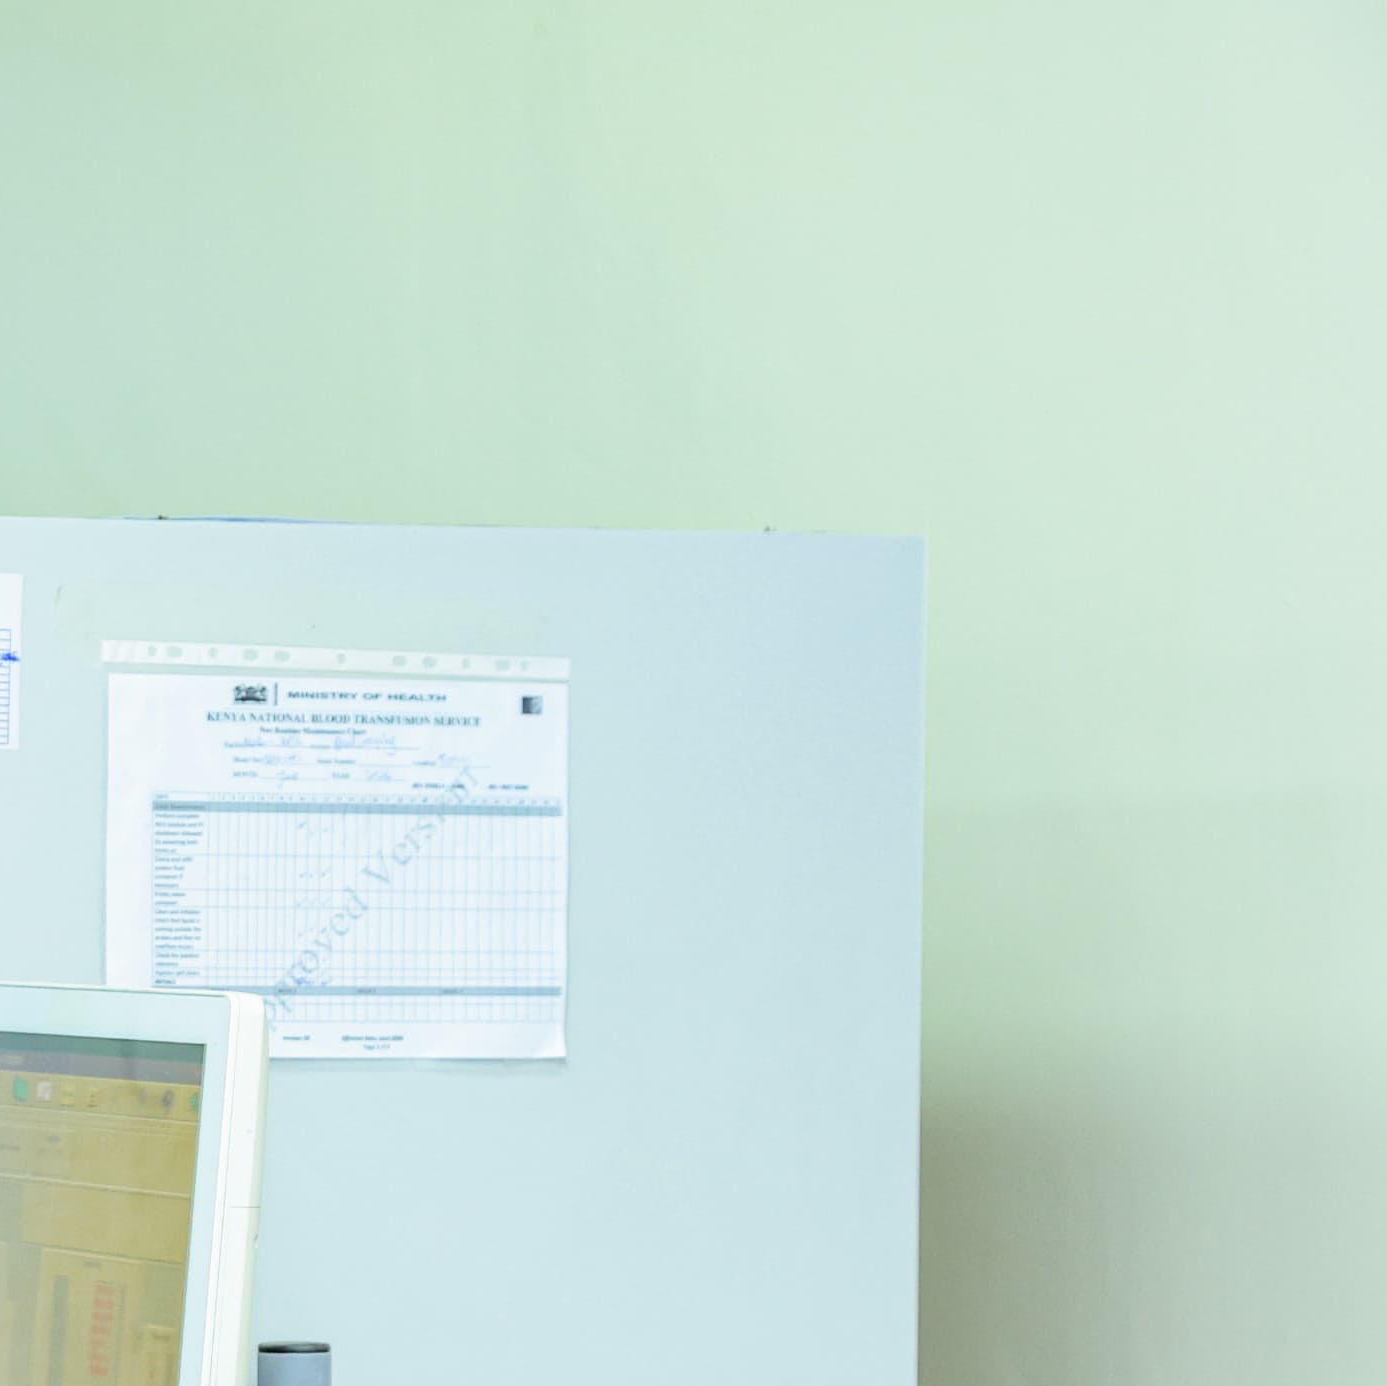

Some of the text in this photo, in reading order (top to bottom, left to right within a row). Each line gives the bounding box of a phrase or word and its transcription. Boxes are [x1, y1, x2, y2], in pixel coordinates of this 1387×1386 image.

[287, 690, 447, 702] MINISTRY OF HEALTH
[206, 711, 482, 727] KENYA NATIONAL BLOOD TRANSFUSION SERVICE
